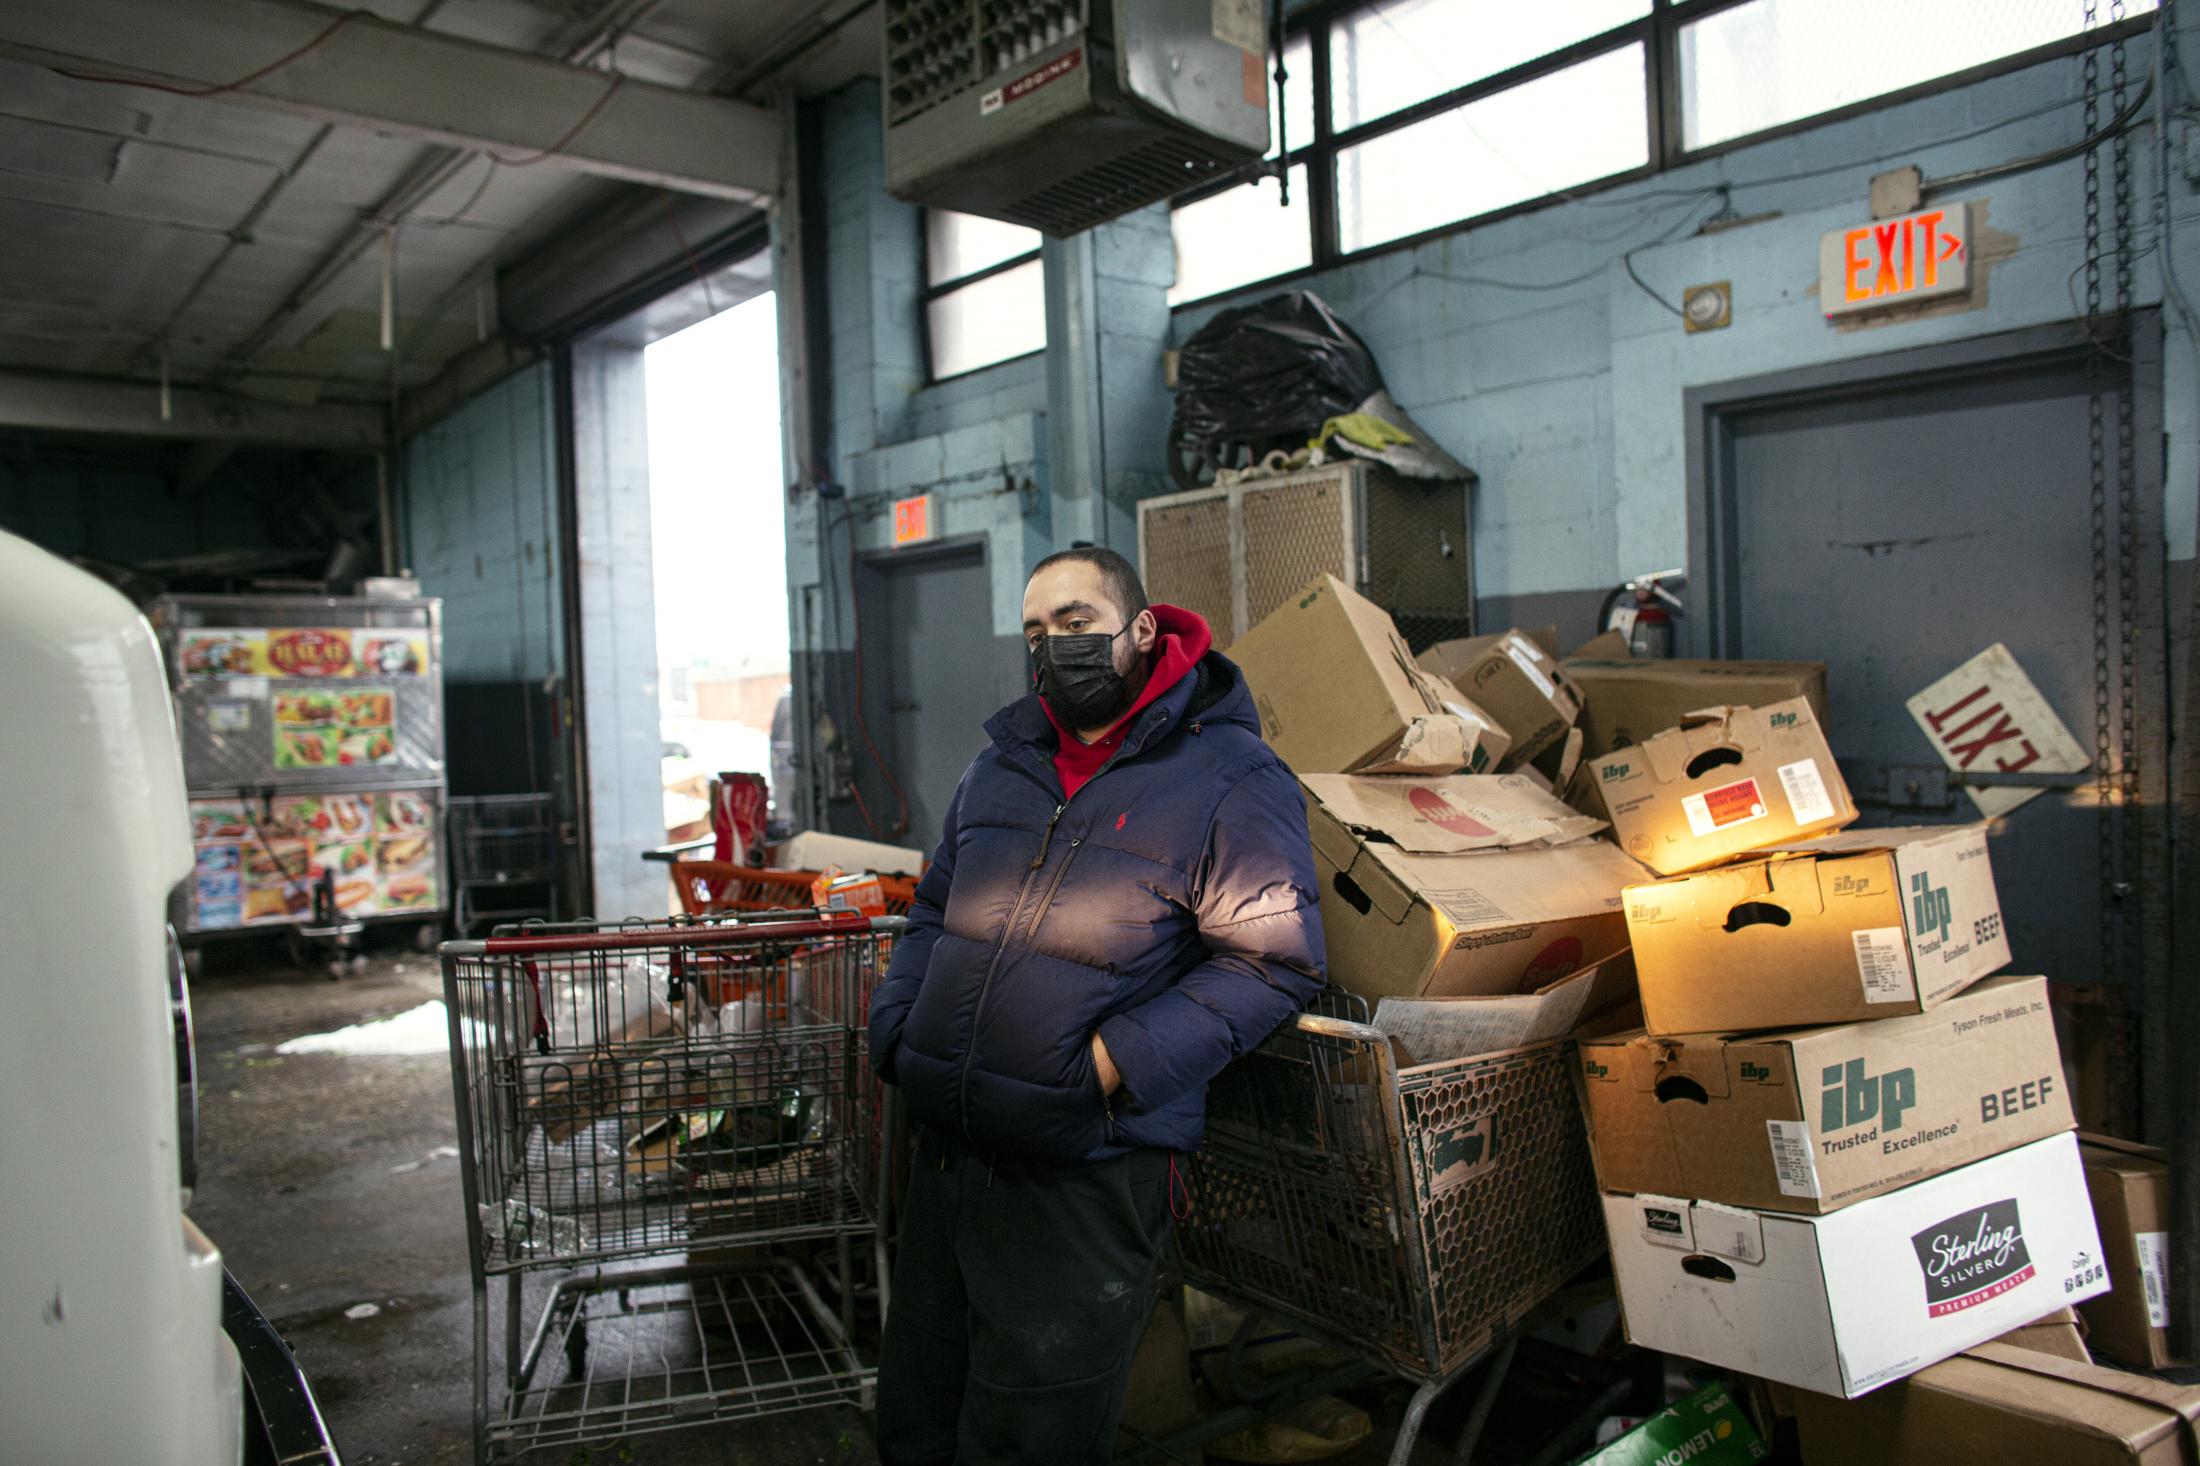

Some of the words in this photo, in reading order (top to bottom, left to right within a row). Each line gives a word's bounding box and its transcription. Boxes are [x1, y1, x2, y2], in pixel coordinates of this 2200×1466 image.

[1844, 210, 1945, 303] EXIT
[1770, 712, 1797, 728] ibp
[1602, 764, 1629, 780] ibp
[1834, 875, 1869, 893] ibp
[1910, 871, 1952, 943] ibp
[1974, 912, 2000, 945] BEEF
[1952, 1018, 1977, 1035] Tyson
[1979, 1011, 2002, 1026] Fresh
[1586, 1061, 1608, 1078] ibp
[1740, 1062, 1770, 1081] ibp
[1821, 1057, 1916, 1133] ibp
[1980, 1076, 2053, 1123] BEEF
[1822, 1126, 1878, 1155] Trusted
[1882, 1121, 1958, 1155] Excellence
[1927, 1212, 2022, 1277] Sterling
[1941, 1259, 1994, 1288] SILVER
[1939, 1292, 1989, 1313] PREMIUM
[1994, 1272, 2027, 1294] MEATS
[1655, 1429, 1716, 1466] LEMON
